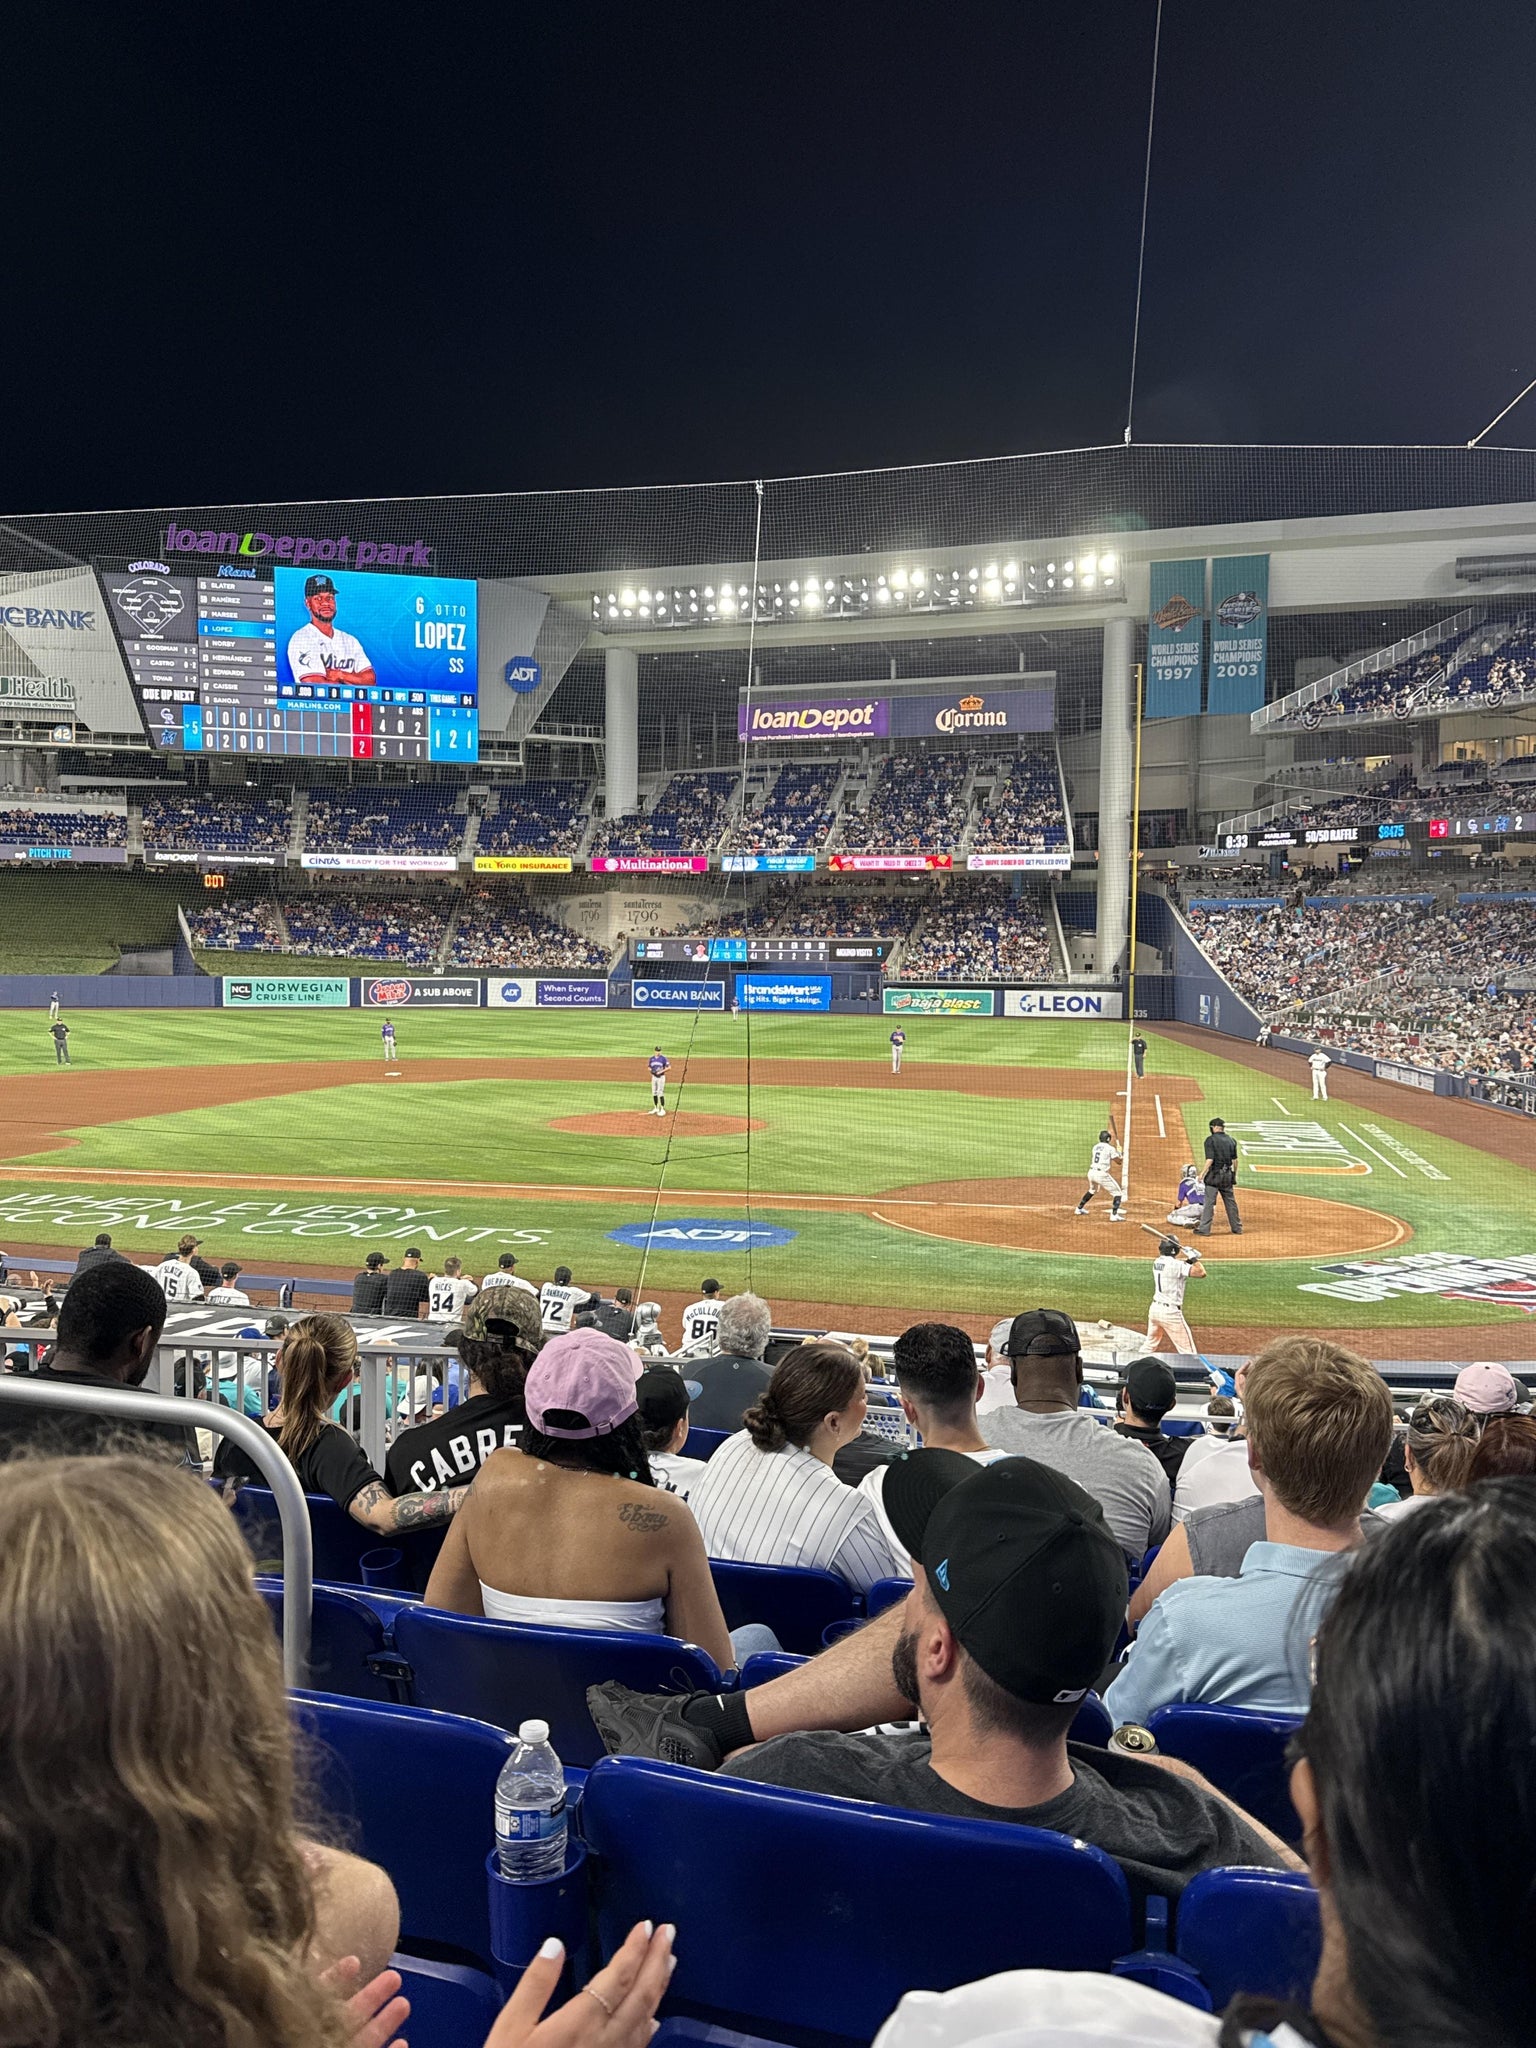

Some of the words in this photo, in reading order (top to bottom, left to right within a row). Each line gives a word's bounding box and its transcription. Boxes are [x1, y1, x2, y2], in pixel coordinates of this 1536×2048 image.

[166, 523, 351, 565] loanDepot
[355, 540, 433, 569] park
[128, 561, 170, 575] COLORADO
[217, 564, 256, 578] Miami
[211, 582, 236, 590] SLATER
[415, 596, 424, 614] 6
[435, 604, 466, 617] OTTO
[1217, 605, 1261, 615] SERIES
[211, 611, 239, 619] MARSEE
[415, 620, 466, 651] LOPEZ
[1151, 643, 1175, 655] WORLD
[1175, 642, 1199, 654] SERIES
[1213, 640, 1238, 652] WORLD
[1238, 639, 1263, 650] SERIES
[212, 654, 253, 663] HERNÁNDEZ
[1151, 655, 1199, 667] CHAMPIONS
[1213, 651, 1262, 664] CHAMPIONS
[212, 669, 245, 677] EDWARDS
[449, 658, 464, 674] SS
[1216, 664, 1258, 678] 2003
[510, 667, 537, 682] ADT
[1157, 667, 1192, 681] 1997
[142, 688, 160, 700] DUE
[161, 689, 172, 701] UP
[173, 690, 196, 702] NEXT
[287, 701, 341, 711] MARLINS.COM
[206, 711, 212, 725] 0
[223, 711, 229, 726] 0
[240, 712, 246, 726] 0
[258, 713, 262, 727] 1
[274, 714, 280, 728] 0
[752, 704, 874, 732] loanDepot
[935, 708, 1007, 734] Corona
[54, 728, 71, 739] 42
[192, 721, 198, 735] 5
[360, 718, 364, 731] 1
[379, 719, 386, 733] 4
[398, 720, 404, 734] 0
[414, 721, 421, 735] 2
[206, 734, 213, 748] 0
[223, 734, 230, 748] 2
[240, 735, 247, 749] 0
[257, 736, 264, 750] 0
[436, 730, 440, 748] 1
[449, 729, 457, 749] 2
[467, 730, 472, 749] 1
[359, 741, 365, 754] 2
[380, 742, 386, 756] 5
[1438, 823, 1445, 835] 5
[1514, 815, 1523, 830] 2
[1225, 834, 1248, 848] 8:33
[1257, 838, 1297, 847] FOUNDATION
[1305, 830, 1329, 843] 50/50
[1329, 828, 1359, 842] RAFFLE
[28, 848, 51, 858] PITCH
[52, 848, 72, 859] TYPE
[155, 852, 198, 862] loanDepot
[620, 859, 693, 870] Multinational
[581, 909, 600, 924] 1796
[628, 909, 659, 924] 1796
[765, 952, 769, 960] 5
[877, 947, 882, 957] 3
[232, 985, 251, 993] NCL
[256, 983, 343, 993] NORWEGIAN
[414, 988, 421, 997] A
[423, 988, 441, 997] SUB
[443, 988, 473, 997] ABOVE
[504, 989, 519, 997] ADT
[544, 984, 566, 992] When
[568, 985, 590, 994] Every
[744, 984, 810, 995] BrandsMart
[256, 993, 295, 1001] CRUISE
[651, 990, 689, 1000] OCEAN
[690, 991, 720, 1001] BANK
[772, 996, 793, 1004] Bigger
[910, 998, 942, 1009] Baja
[942, 998, 982, 1009] Blast
[1039, 996, 1102, 1012] LEON
[1133, 1009, 1148, 1018] 335
[1094, 1152, 1101, 1164] 6
[0, 1193, 215, 1212] WHEN
[210, 1202, 450, 1221] EVERY
[242, 1220, 552, 1245] COUNTS.
[632, 1228, 773, 1242] ADT
[164, 1275, 177, 1298] 15
[1157, 1273, 1162, 1293] 1
[432, 1293, 454, 1313] 34
[542, 1299, 564, 1322] 72
